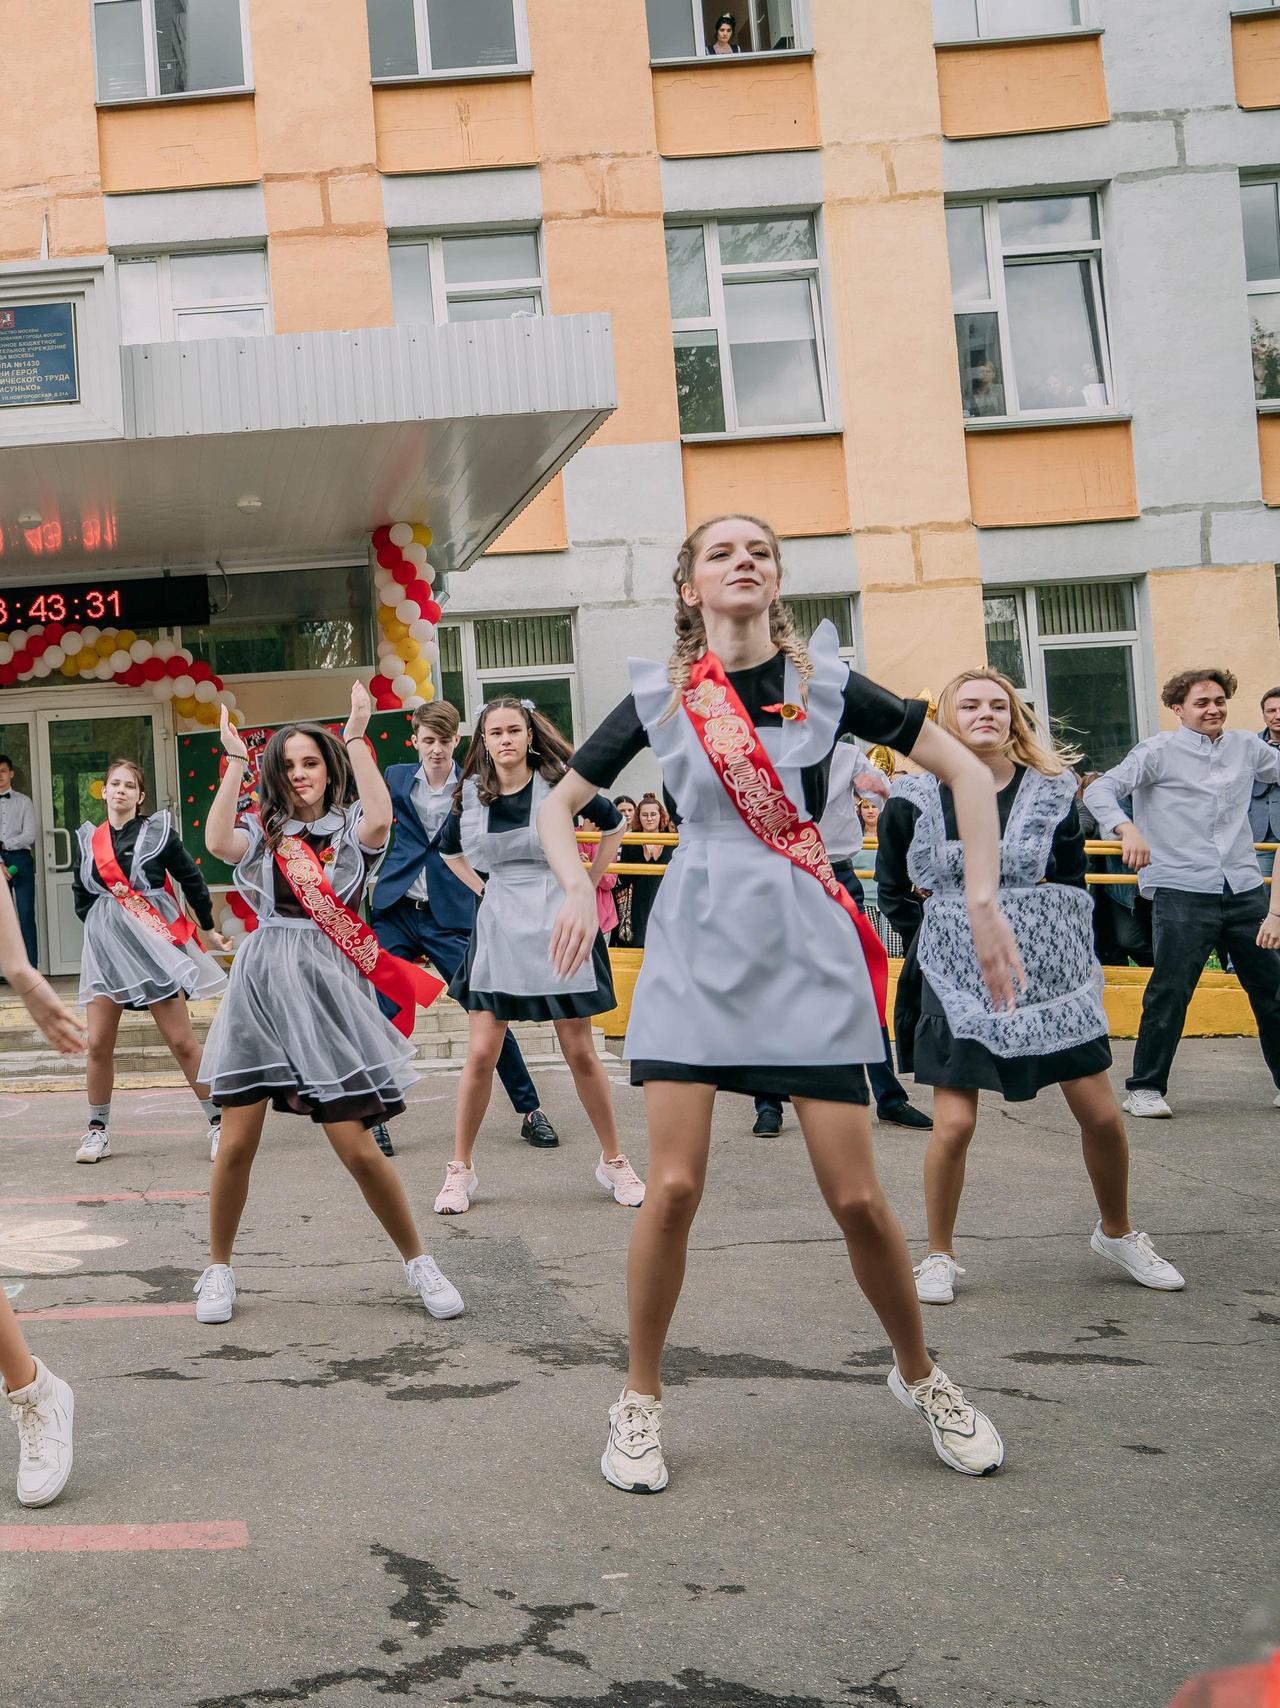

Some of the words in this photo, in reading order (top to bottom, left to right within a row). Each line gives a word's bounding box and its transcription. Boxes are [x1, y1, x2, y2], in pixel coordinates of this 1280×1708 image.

[19, 339, 57, 347] БЮДЖЕТНОЕ
[27, 344, 68, 352] УЧРЕЖДЕНИЕ
[14, 360, 40, 368] №1430
[11, 368, 38, 376] ГЕРОЯ
[44, 373, 70, 381] ТРУДА
